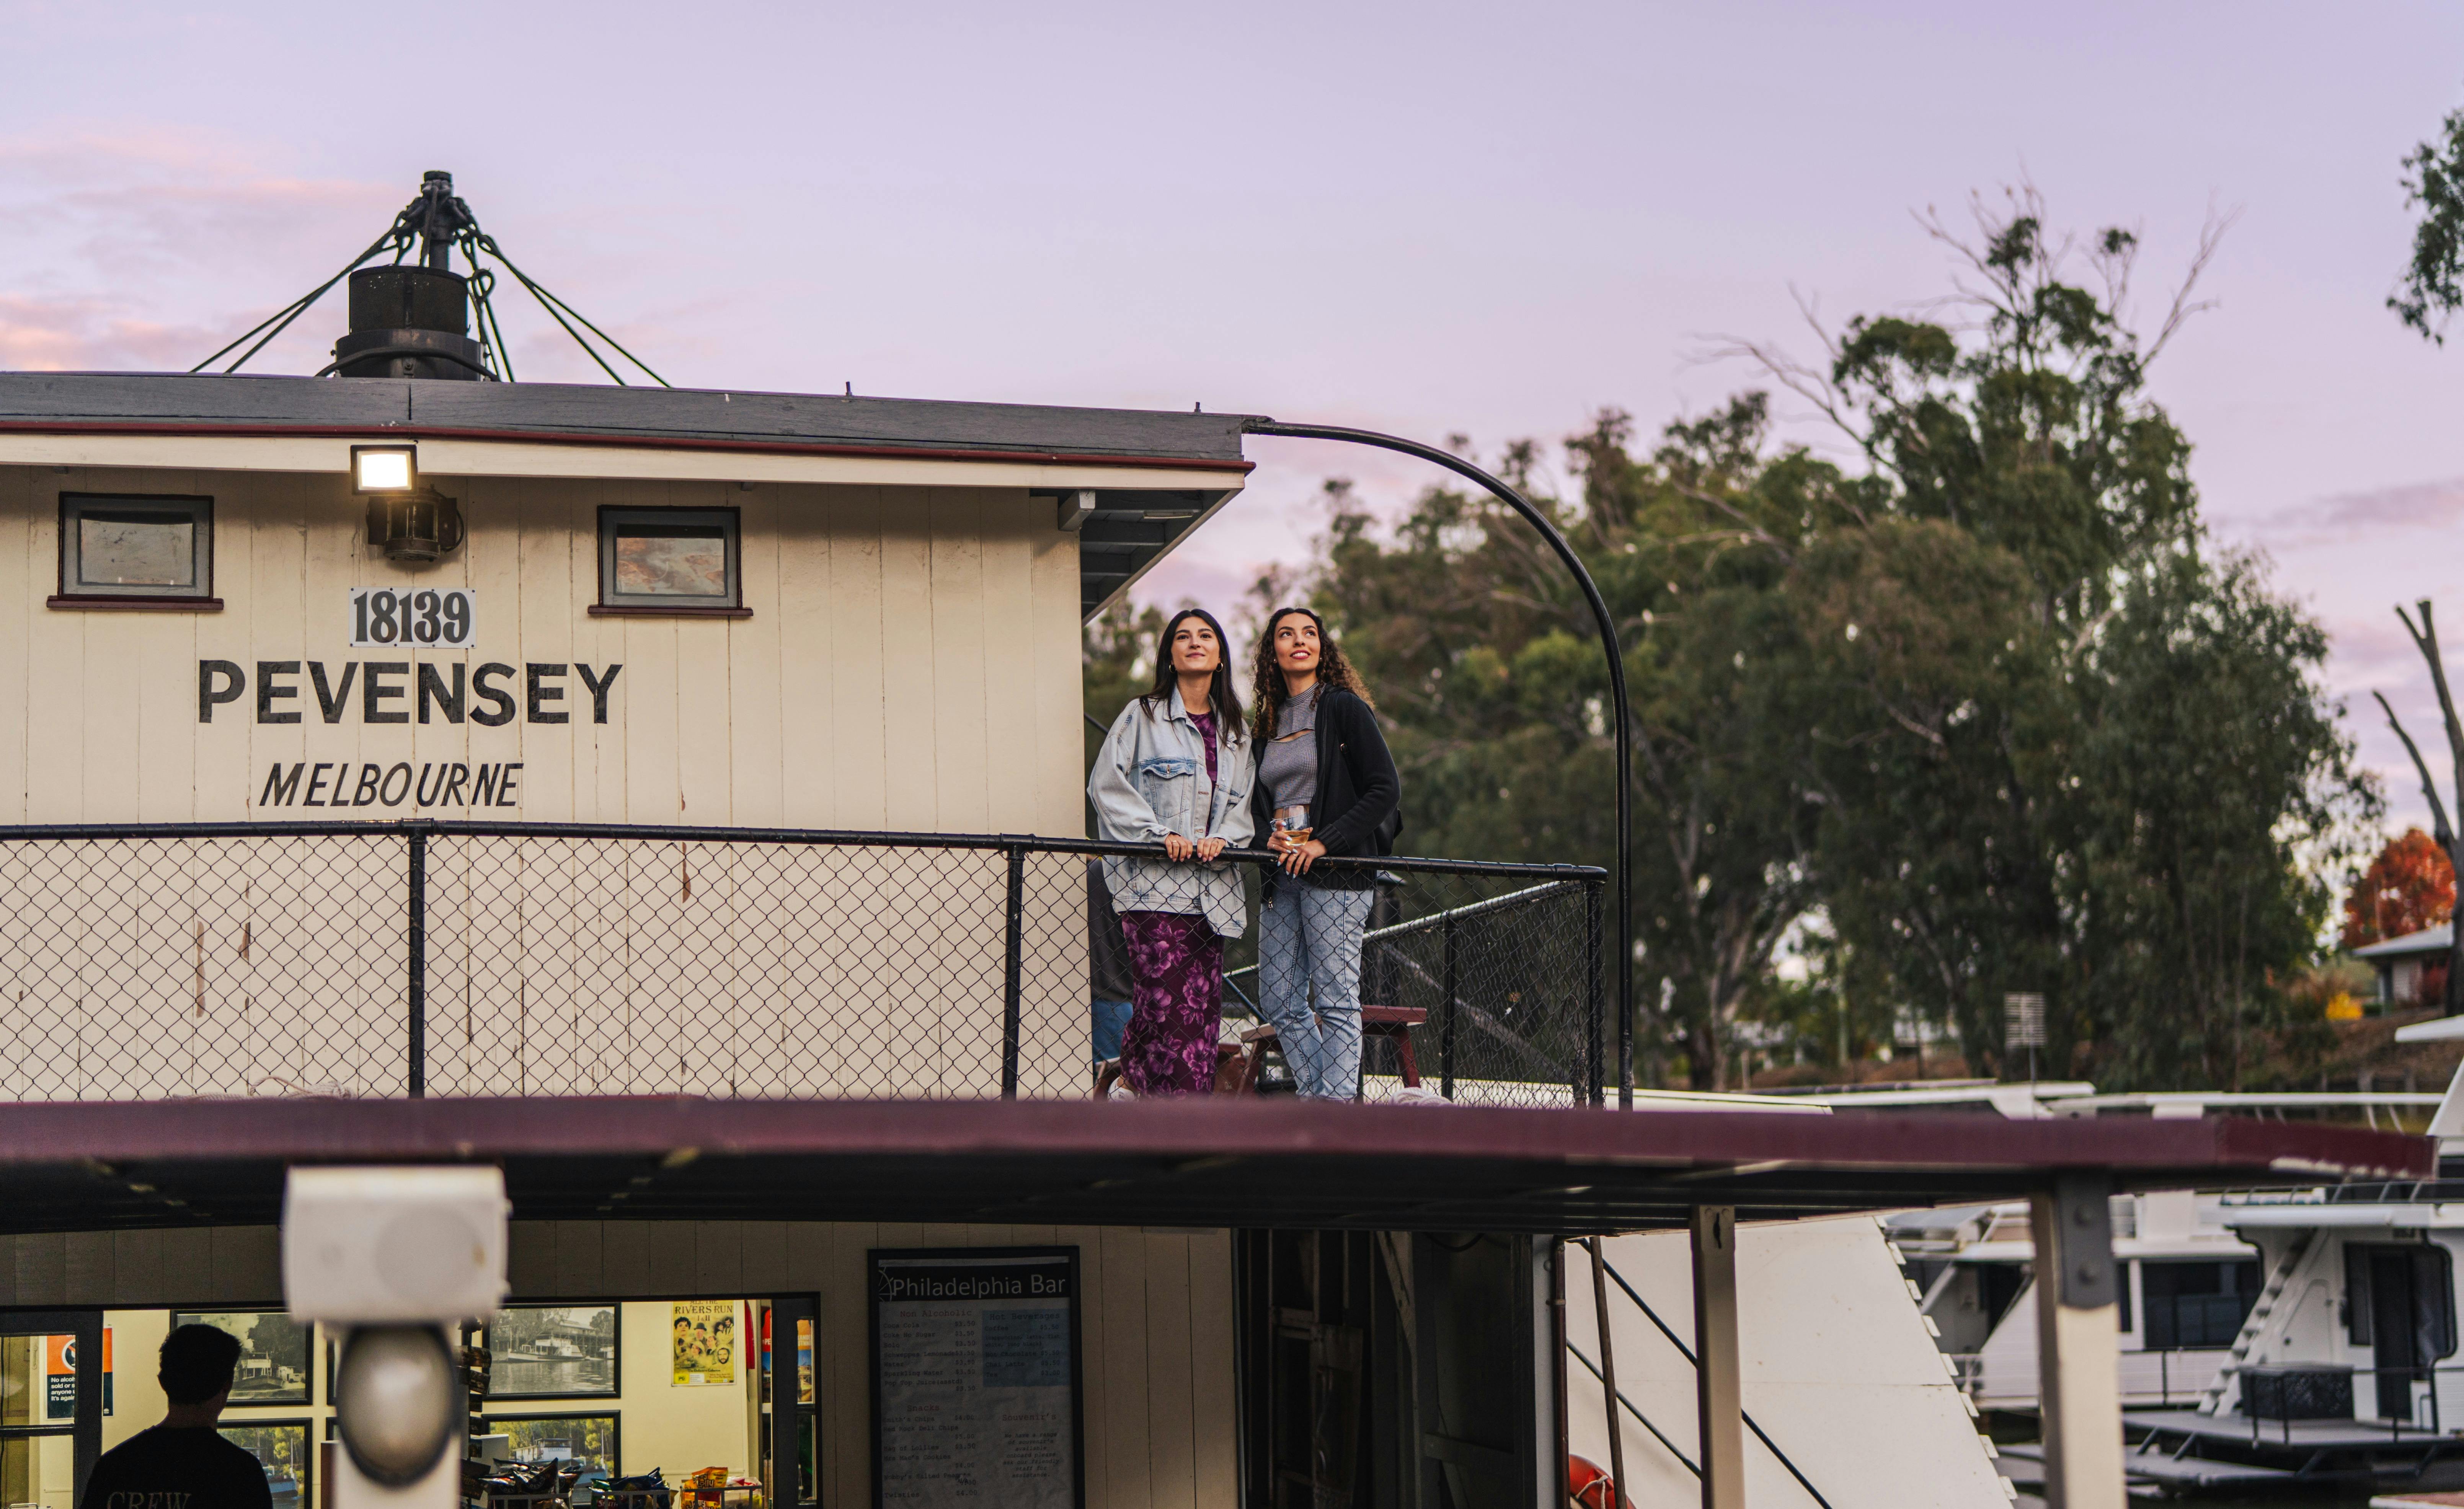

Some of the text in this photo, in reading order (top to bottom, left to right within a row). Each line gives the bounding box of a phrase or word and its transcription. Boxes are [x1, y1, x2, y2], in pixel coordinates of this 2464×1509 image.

[353, 590, 471, 644] 18139
[199, 659, 623, 726] PEVENSEY
[259, 762, 524, 806] MELBOURNE
[893, 1274, 1065, 1299] Philadelphia Bar
[675, 1305, 712, 1314] RIVERS
[107, 1490, 191, 1509] CREW
